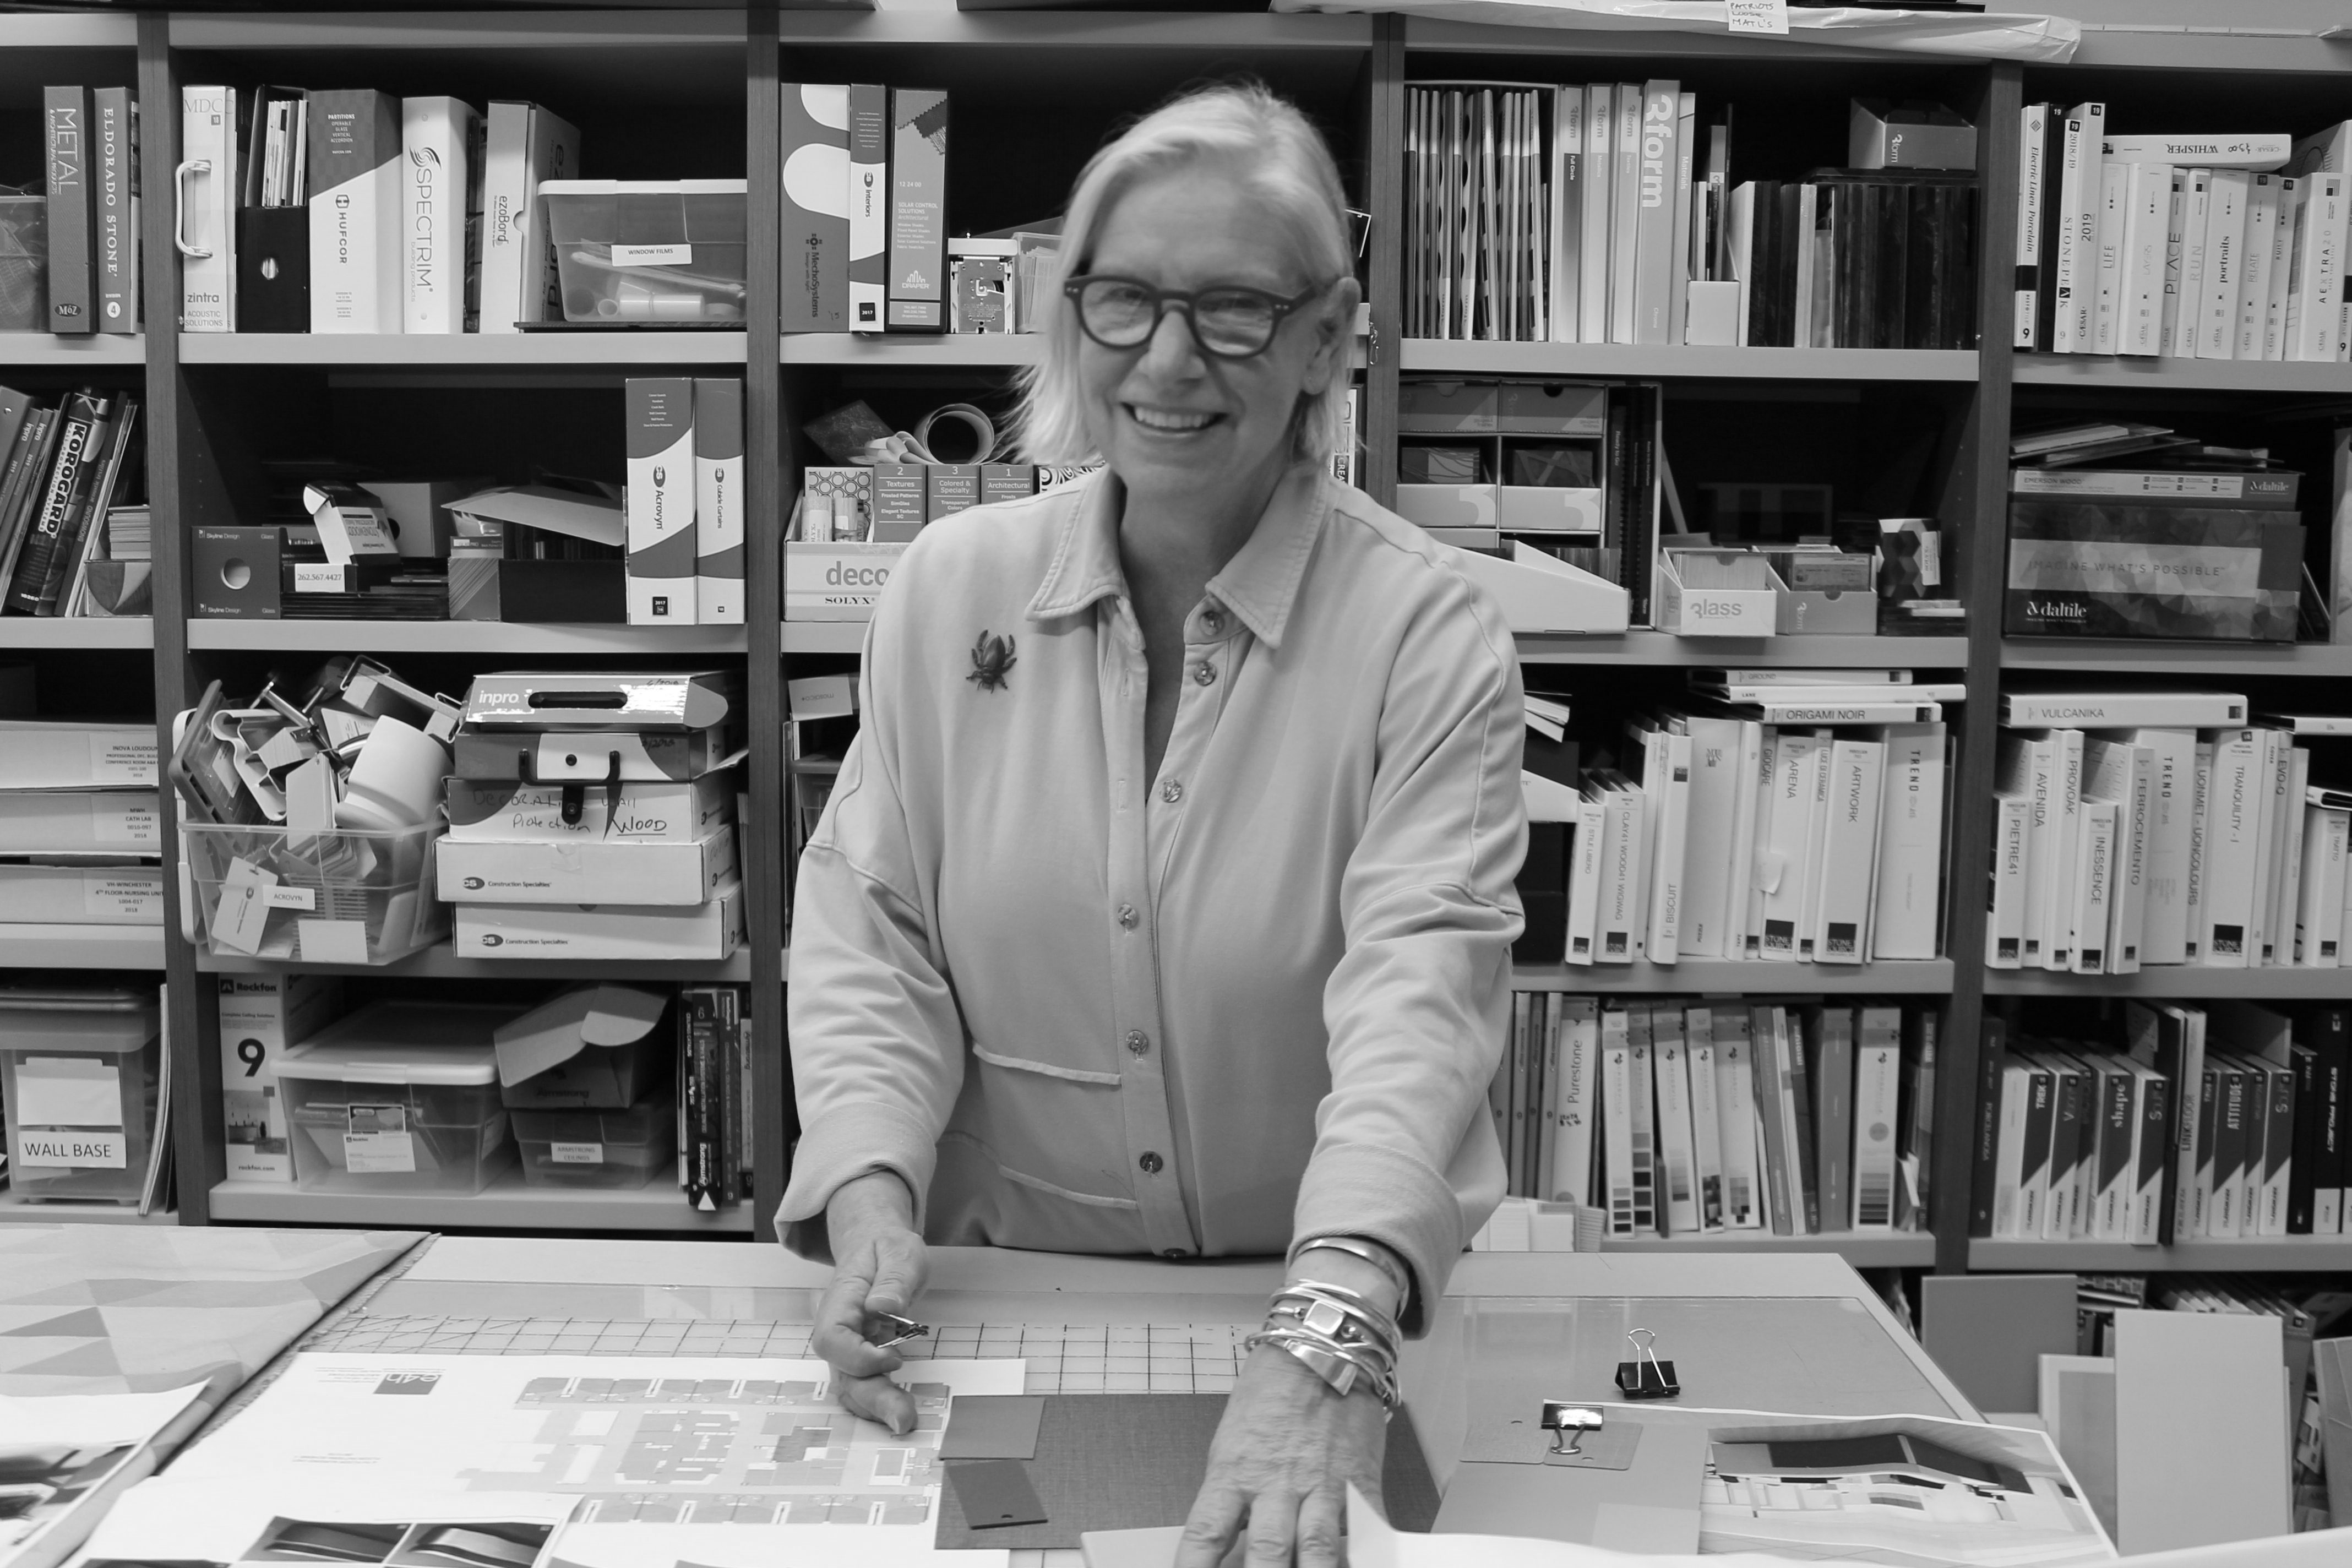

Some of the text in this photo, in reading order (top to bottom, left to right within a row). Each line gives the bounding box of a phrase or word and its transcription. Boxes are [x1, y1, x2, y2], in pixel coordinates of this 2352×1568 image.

[183, 99, 223, 114] MDC
[56, 108, 78, 195] METAL
[1641, 94, 1673, 208] 3form
[2068, 134, 2078, 169] 2018/19
[2166, 144, 2219, 154] WHISPER
[104, 108, 117, 274] ELDORADO STONE
[1679, 156, 1689, 190] Materials
[2027, 146, 2039, 252] Electric Linen Porcelain
[338, 211, 348, 264] HUFCOR
[416, 167, 432, 287] SPECTRIM
[497, 195, 510, 243] ezoBord
[2082, 213, 2093, 242] 2019
[2059, 216, 2073, 308] STONEPEAK
[2103, 245, 2114, 269] LIFE
[2190, 245, 2202, 281] RUN
[2219, 236, 2230, 284] portraits
[2248, 253, 2258, 283] RELATE
[187, 292, 220, 304] zintra
[811, 252, 820, 318] MechoSystems
[110, 304, 117, 315] 4
[2023, 328, 2030, 339] 9
[38, 445, 67, 533] PROTECTION SYSTEMS
[46, 423, 87, 538] KOROGARD
[897, 466, 903, 475] 2
[952, 466, 959, 475] 3
[1006, 469, 1011, 477] 1
[2258, 480, 2290, 492] daltile
[940, 487, 970, 495] Specialty
[78, 505, 94, 542] SNOWSOUND
[654, 490, 663, 530] Acrovyn
[297, 573, 342, 582] 262.567.4427
[2028, 560, 2220, 576] IMAGINE WHAT'S POSSIBLE
[2040, 602, 2087, 618] daltile
[478, 690, 519, 705] inpro
[1786, 710, 1866, 720] ORIGAMI NOIR
[2041, 708, 2105, 718] VULCANIKA
[1762, 748, 1773, 787] GIOCARE
[1786, 759, 1799, 799] ARENA
[1909, 750, 1920, 792] TREND
[2162, 756, 2173, 798] TREND
[1848, 765, 1862, 823] ARTWORK
[2034, 772, 2047, 827] AVENIDA
[2066, 760, 2078, 815] PROVOAK
[2233, 766, 2245, 831] TRANQUILITY
[2008, 819, 2021, 876] PIETRE41
[2130, 778, 2147, 886] FERROCEMENTO
[1585, 848, 1593, 874] LIBERO
[1615, 812, 1630, 921] CLAY41 WOOD41 WIGWAG
[2091, 836, 2105, 905] INESSENCE
[274, 894, 303, 902] ACROVYN
[1666, 883, 1677, 923] BISCUIT
[540, 938, 569, 946] Specialties
[237, 982, 276, 992] Rockfon
[237, 1038, 265, 1077] 9
[1567, 1039, 1583, 1104] Purestone
[2035, 1085, 2047, 1110] TREK
[2110, 1083, 2129, 1129] shape
[2227, 1084, 2242, 1130] ATTITUDE
[25, 1142, 111, 1158] WALL BASE
[238, 1164, 275, 1172] rockfon.com
[699, 1142, 707, 1186] Armstrong
[727, 1192, 733, 1200] 9
[386, 1373, 441, 1385] e4h
